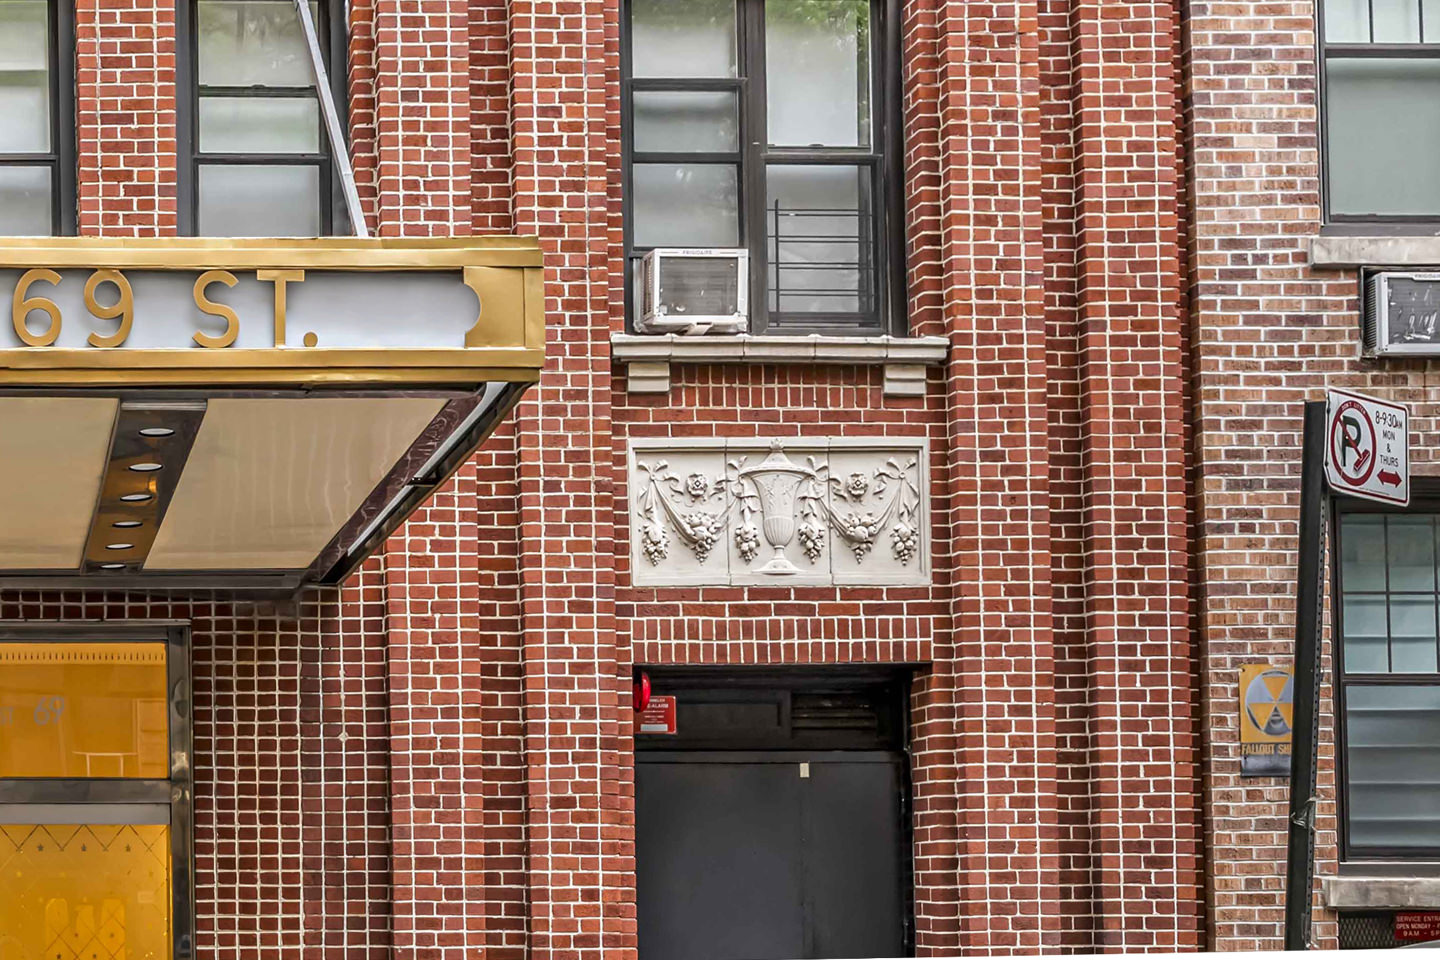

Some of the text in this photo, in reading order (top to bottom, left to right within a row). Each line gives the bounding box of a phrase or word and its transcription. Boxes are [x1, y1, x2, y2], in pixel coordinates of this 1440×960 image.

[12, 267, 134, 348] 69
[192, 269, 319, 348] ST.
[1382, 429, 1396, 441] MON
[1386, 443, 1391, 453] &
[1380, 454, 1399, 468] THURS
[33, 695, 66, 727] 69
[1241, 743, 1275, 755] FALLOUT
